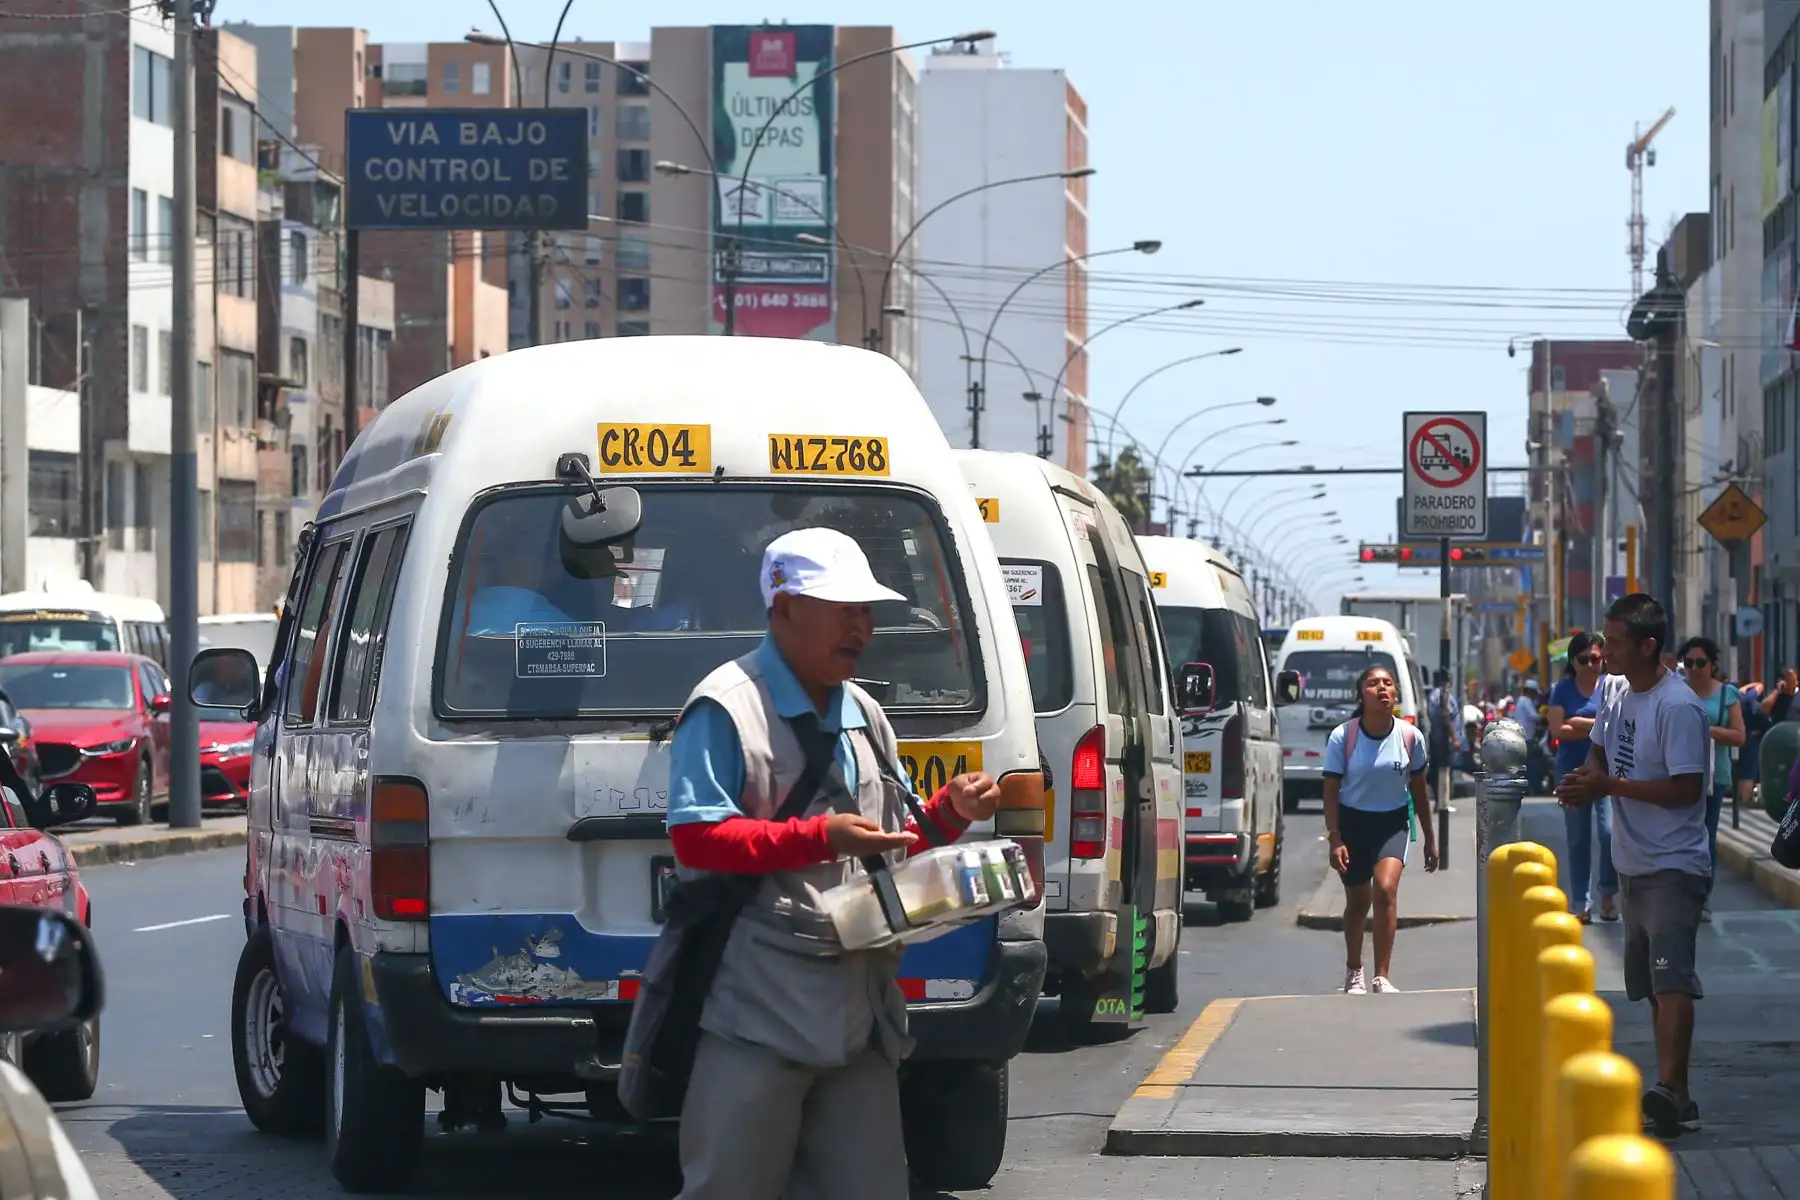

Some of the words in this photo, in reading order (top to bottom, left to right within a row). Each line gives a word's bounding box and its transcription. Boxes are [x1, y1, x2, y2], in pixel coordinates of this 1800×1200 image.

[732, 92, 813, 117] ÚLTIMOS
[387, 122, 440, 145] VIA
[459, 122, 546, 145] BAJO
[741, 127, 804, 147] DEPAS
[364, 158, 511, 182] CONTROL
[529, 158, 569, 181] DE
[377, 194, 558, 218] VELOCIDAD
[1414, 495, 1476, 509] PARADERO
[1414, 515, 1476, 529] PROHIBIDO
